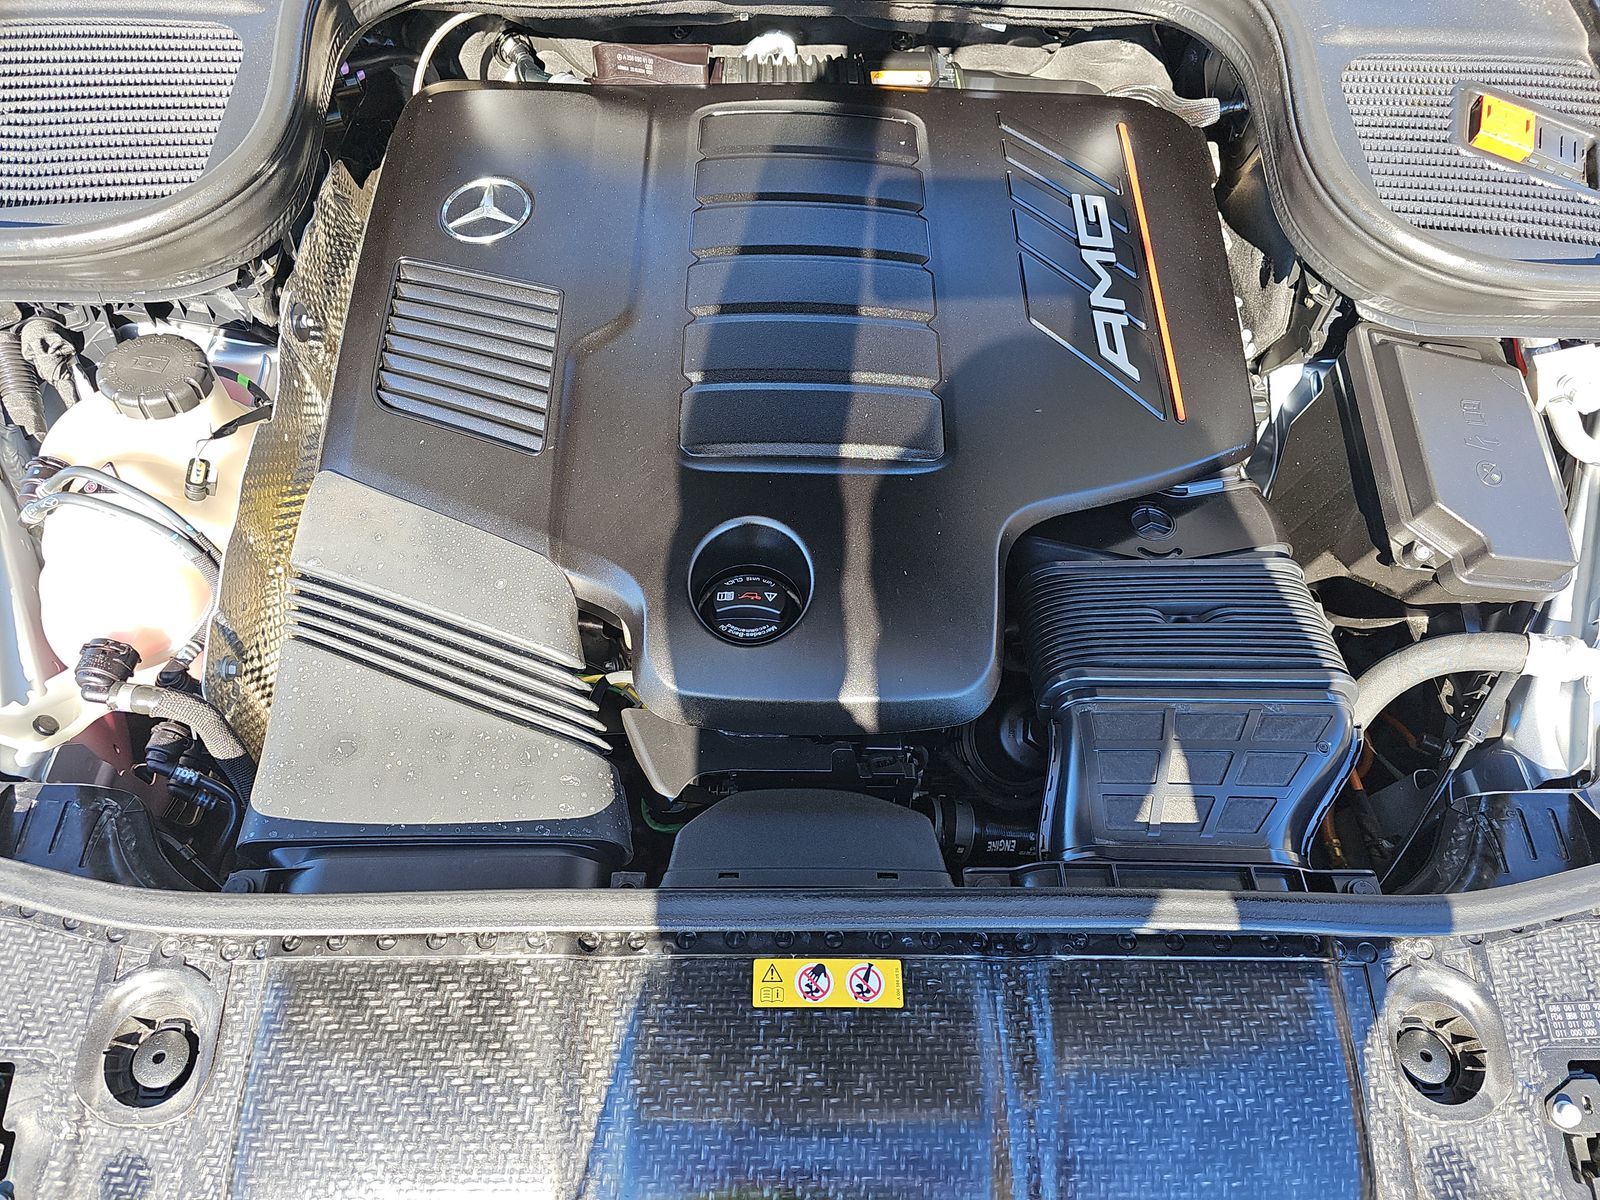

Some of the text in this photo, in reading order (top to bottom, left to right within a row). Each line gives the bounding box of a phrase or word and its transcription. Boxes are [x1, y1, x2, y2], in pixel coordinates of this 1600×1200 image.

[1071, 193, 1141, 382] AMG
[727, 625, 778, 638] Mercedes-Benz
[987, 840, 1017, 852] ENGINE
[1567, 1020, 1580, 1028] 011
[1555, 1029, 1567, 1037] 011
